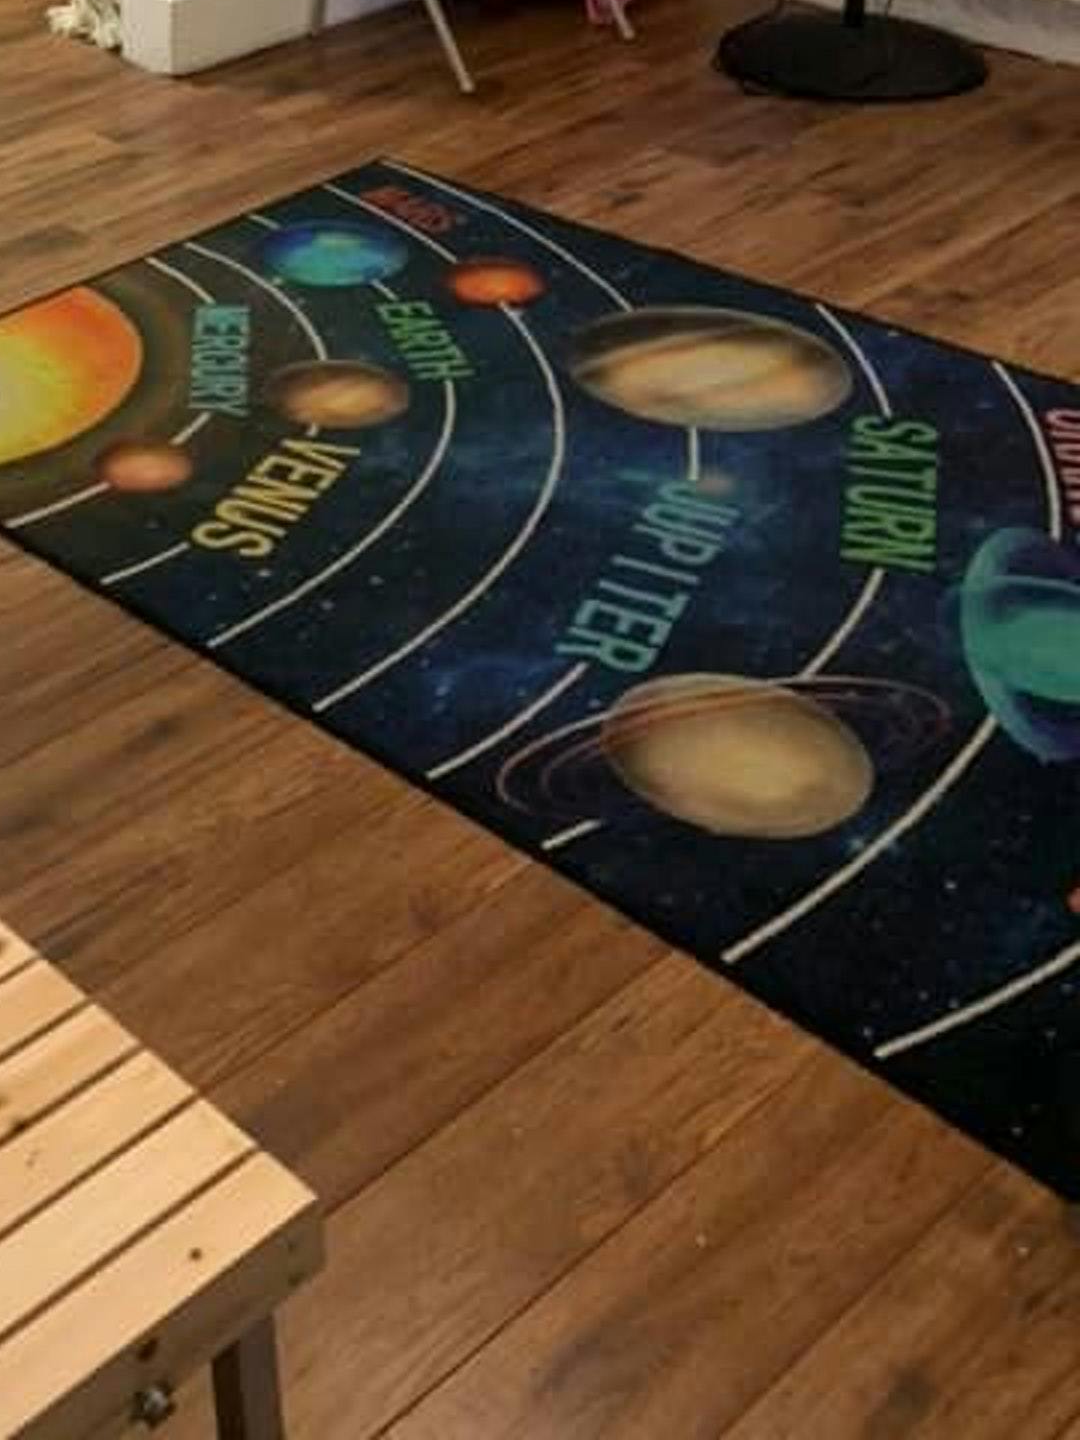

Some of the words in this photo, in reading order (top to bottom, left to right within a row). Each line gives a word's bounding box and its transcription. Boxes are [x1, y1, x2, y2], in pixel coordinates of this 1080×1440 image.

[187, 304, 250, 417] MERCURY
[376, 300, 476, 381] EARTH
[191, 438, 362, 558] VENUS
[840, 414, 940, 573] SATURN
[555, 480, 741, 674] JUPITER
